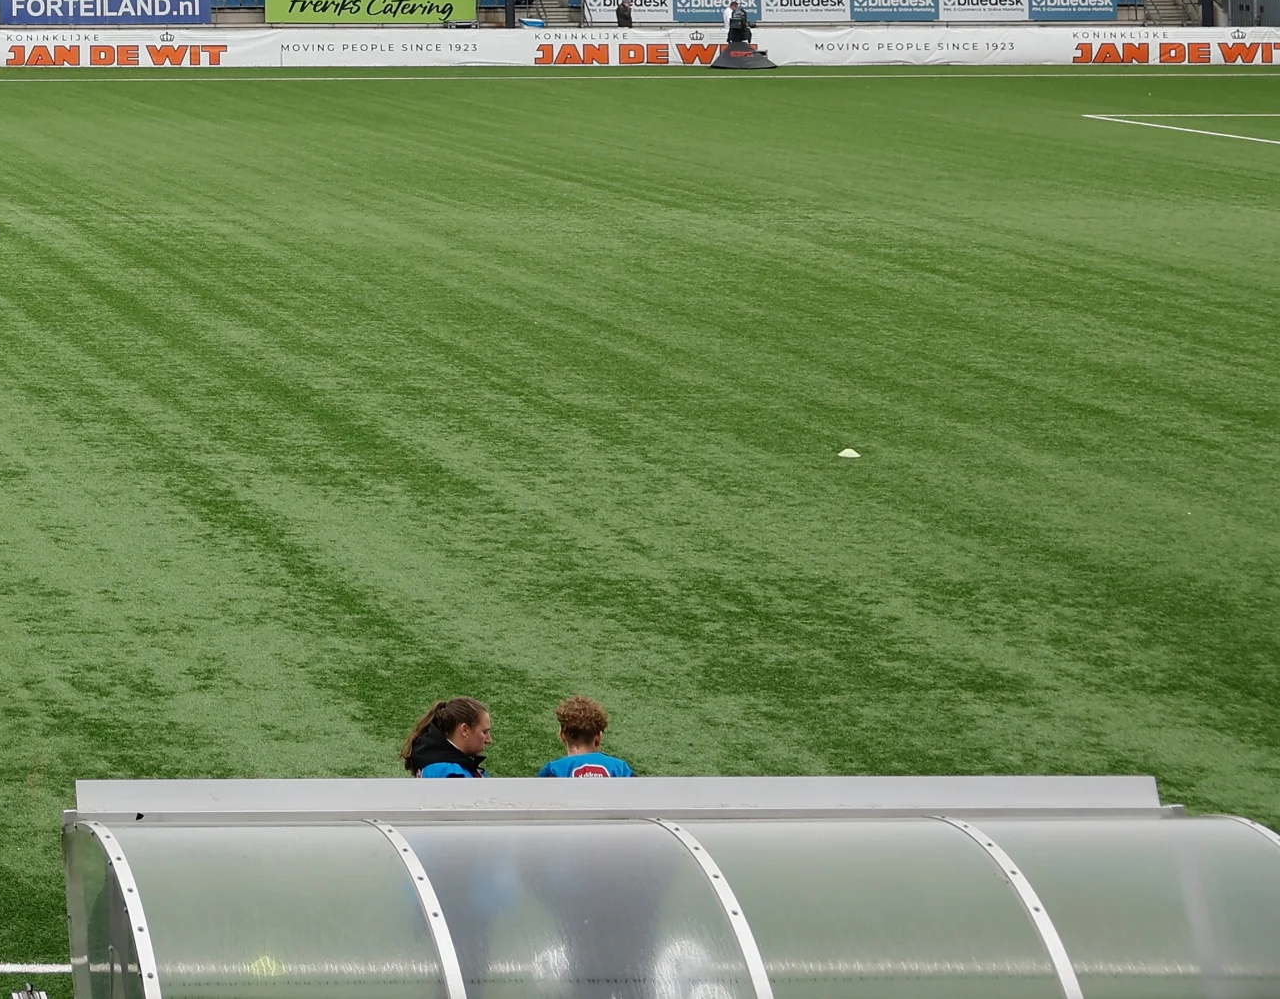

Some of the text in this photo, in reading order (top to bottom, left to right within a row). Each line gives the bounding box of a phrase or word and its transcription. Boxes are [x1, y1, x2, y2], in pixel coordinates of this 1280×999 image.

[1073, 31, 1169, 39] KONINKLIJKE
[1073, 42, 1280, 63] JAN DE WI
